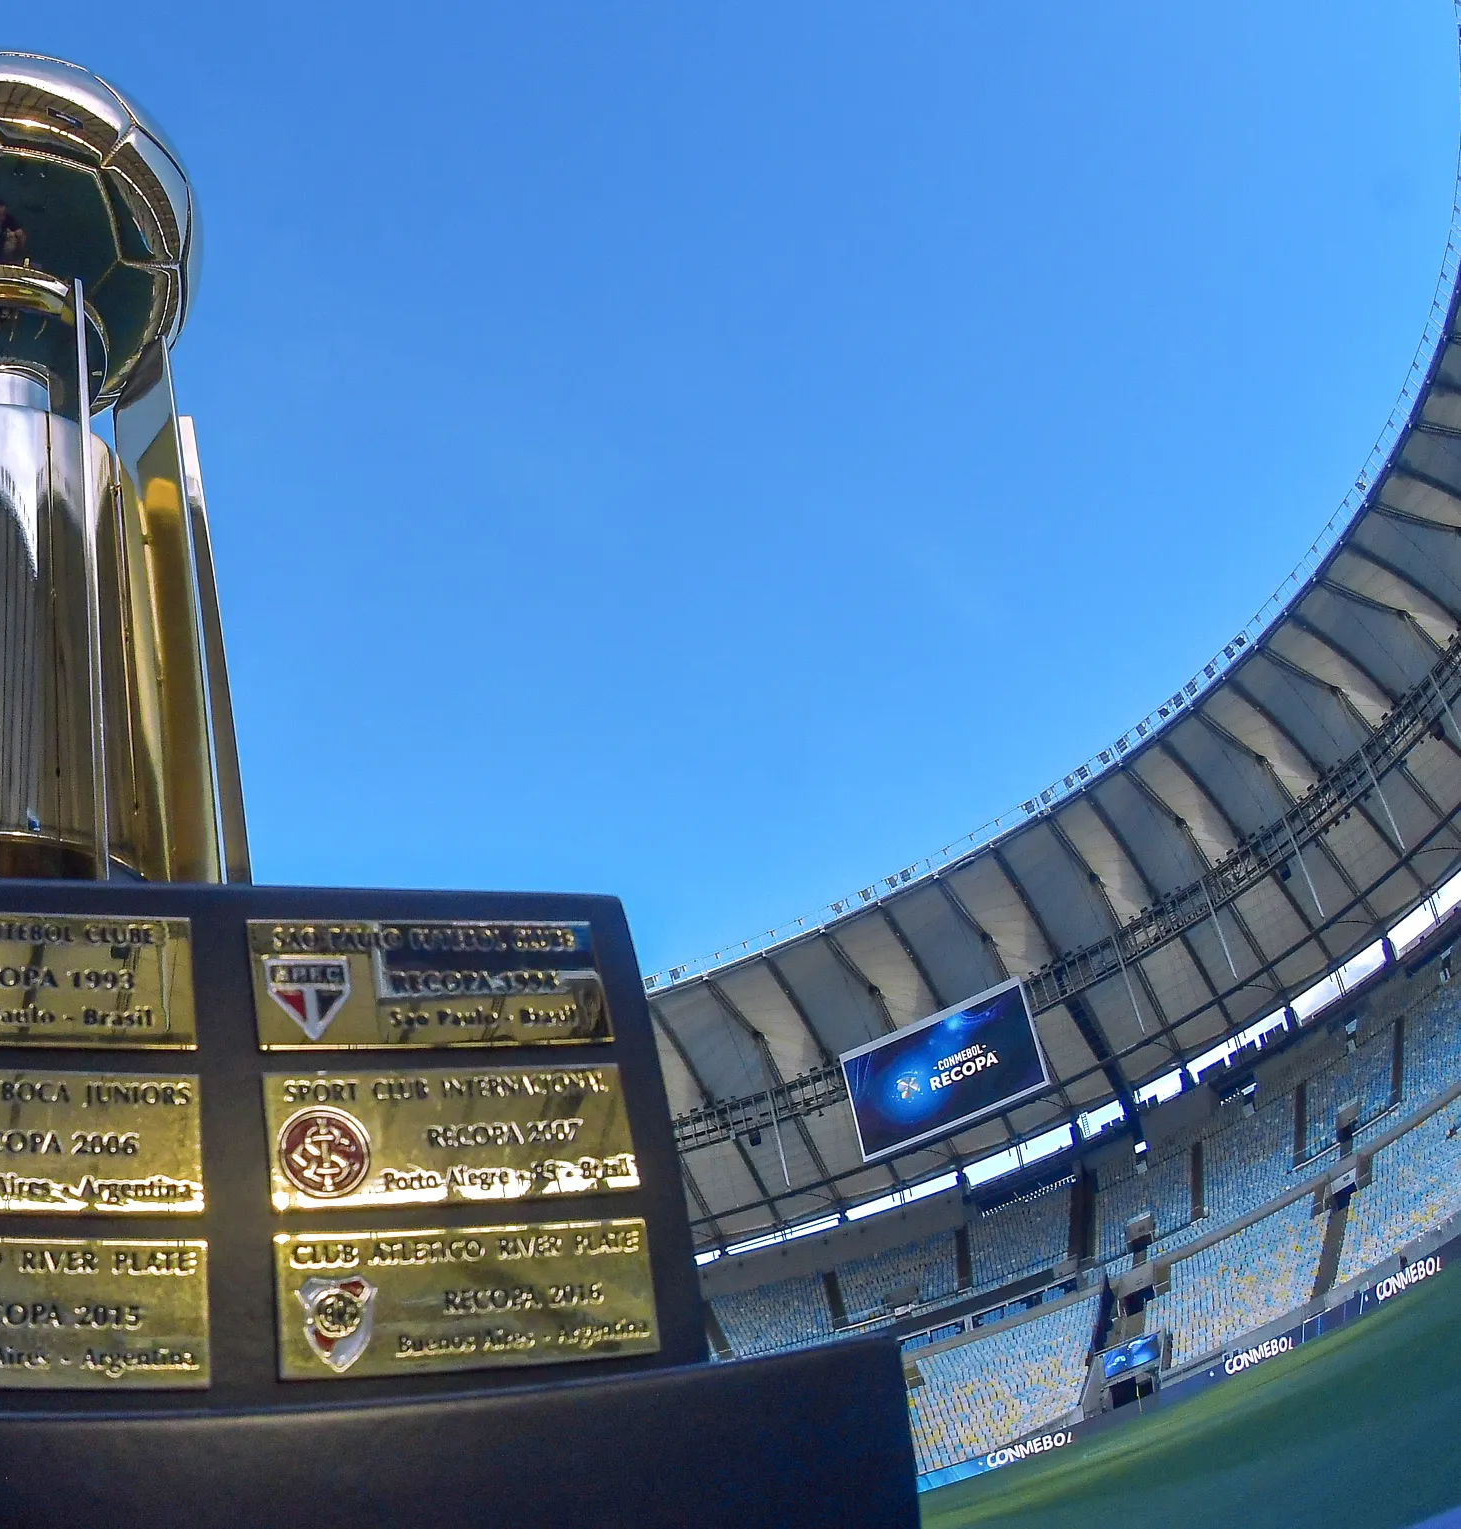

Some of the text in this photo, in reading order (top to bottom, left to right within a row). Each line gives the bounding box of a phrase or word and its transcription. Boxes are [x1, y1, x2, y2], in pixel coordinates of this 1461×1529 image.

[85, 923, 154, 945] CLUBE
[69, 969, 135, 991] 1993
[392, 970, 496, 993] RECOPA
[82, 1006, 152, 1027] Brasil
[929, 1051, 999, 1091] RECOPA
[0, 1080, 70, 1102] BOCA
[83, 1082, 191, 1107] JUNIORS
[284, 1080, 357, 1102] SPORT
[372, 1079, 429, 1100] CLUB
[71, 1132, 139, 1155] 2006
[429, 1120, 524, 1147] RECOPA
[79, 1175, 192, 1202] Argentina
[382, 1168, 439, 1191] Porto
[446, 1164, 509, 1190] Alegre
[19, 1252, 99, 1274] RIVER
[112, 1252, 197, 1275] PLATE
[290, 1244, 358, 1269] CLUB
[497, 1237, 563, 1260] RIVER
[74, 1304, 143, 1330] 2015
[81, 1348, 199, 1378] Argentina
